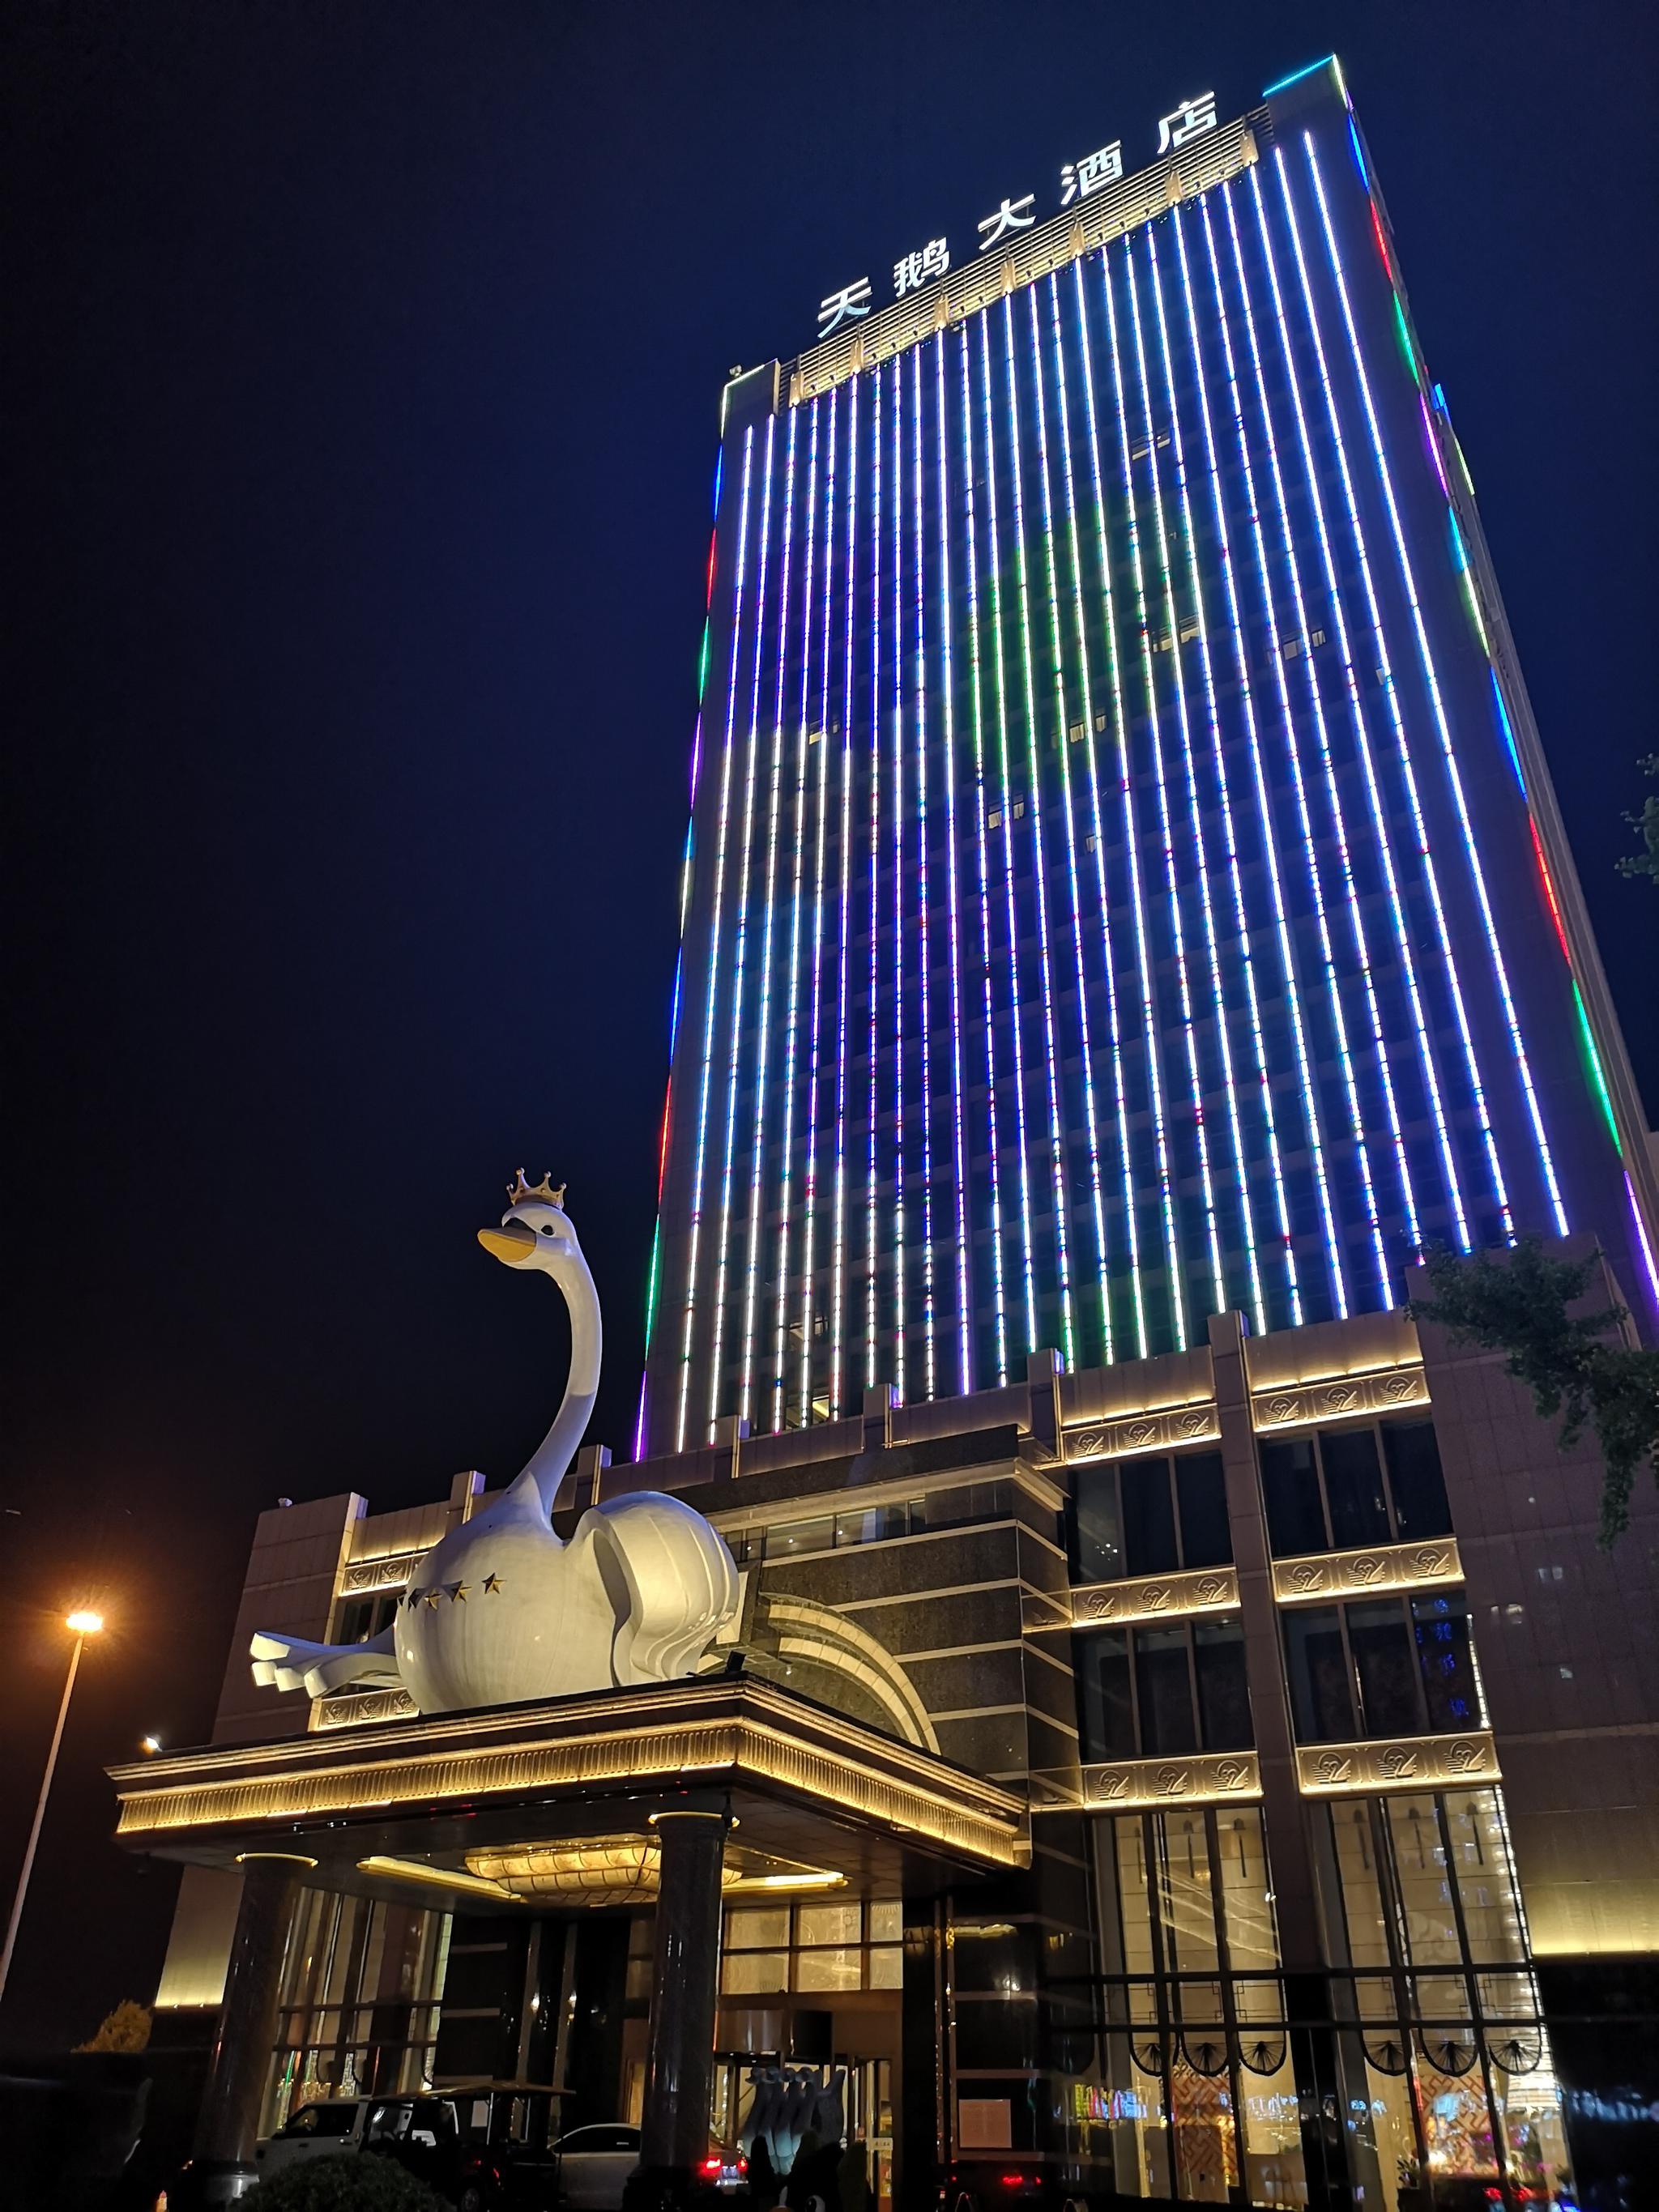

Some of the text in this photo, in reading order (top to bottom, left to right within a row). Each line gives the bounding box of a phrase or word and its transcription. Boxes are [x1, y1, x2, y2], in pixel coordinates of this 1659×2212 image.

[817, 91, 1218, 339] 天鹅大酒店
